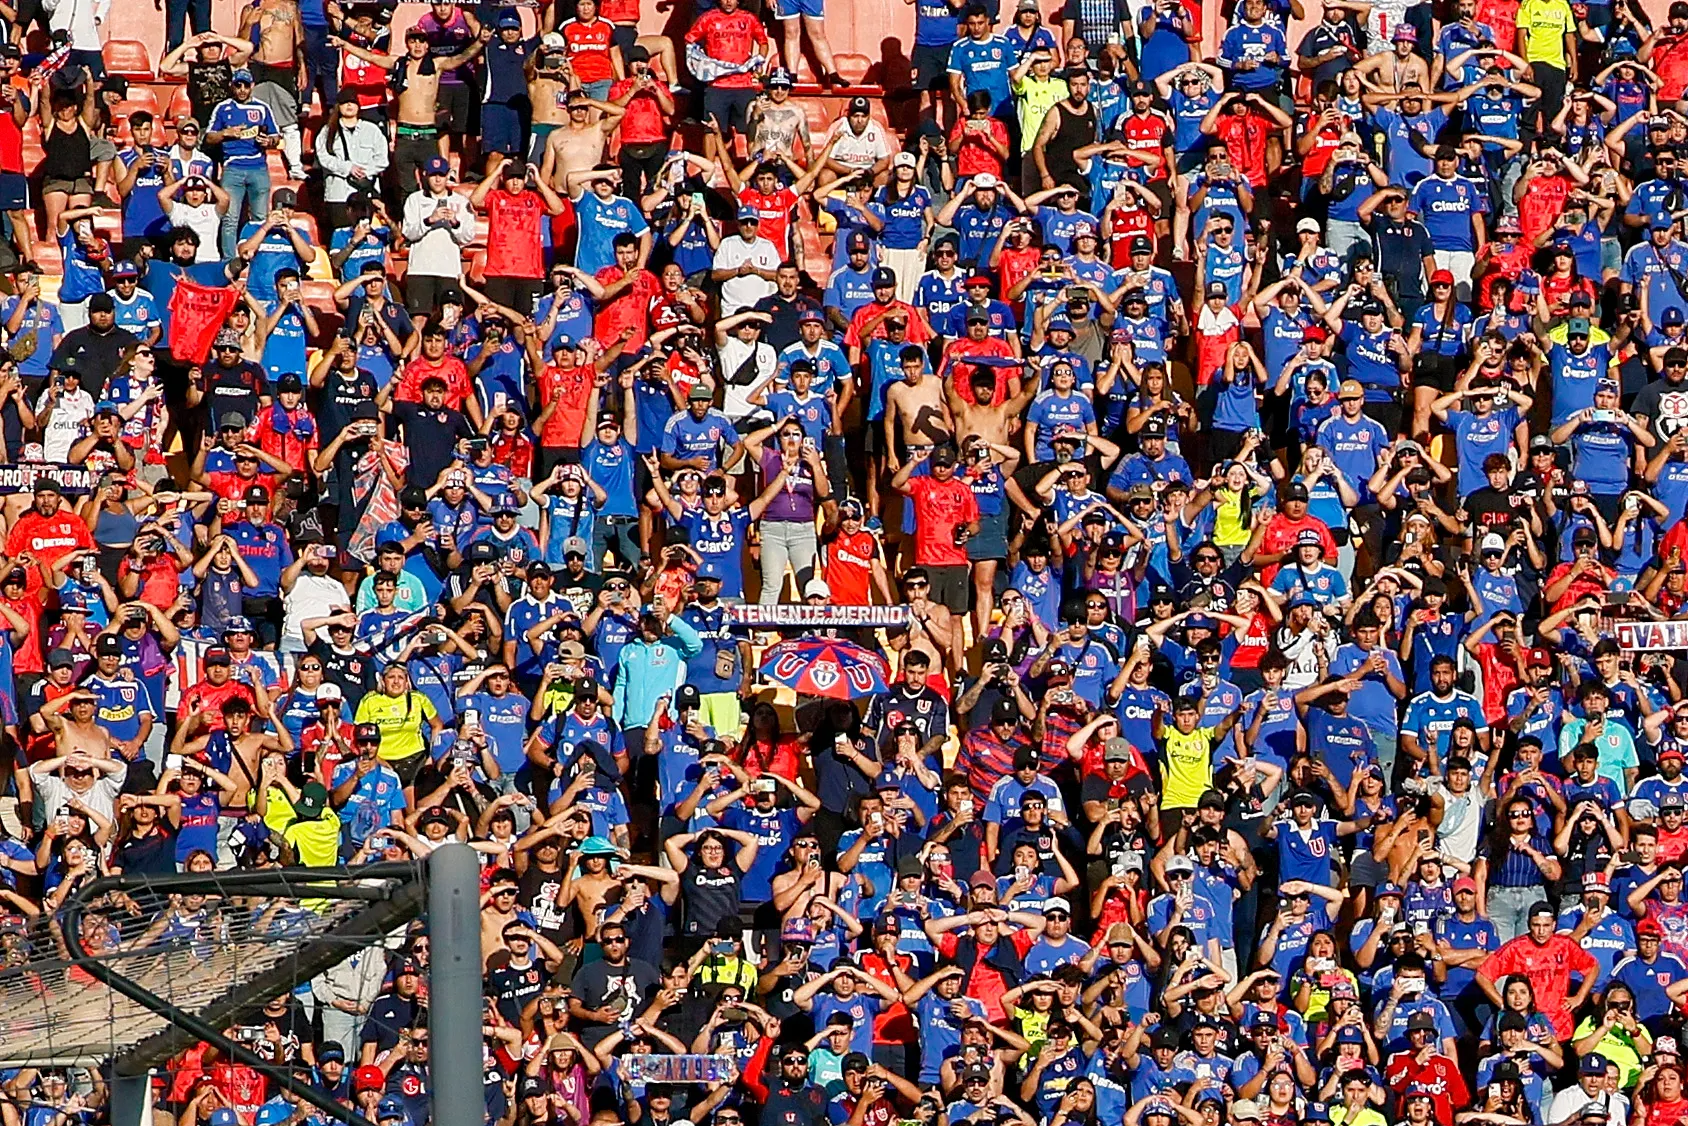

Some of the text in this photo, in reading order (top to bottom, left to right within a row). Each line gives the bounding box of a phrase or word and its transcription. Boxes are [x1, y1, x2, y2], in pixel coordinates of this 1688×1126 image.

[1431, 199, 1466, 212] Claro
[890, 207, 918, 219] Claro
[696, 540, 730, 553] Claro
[735, 605, 904, 624] TENIENTE MERINO
[1126, 706, 1154, 720] Clar
